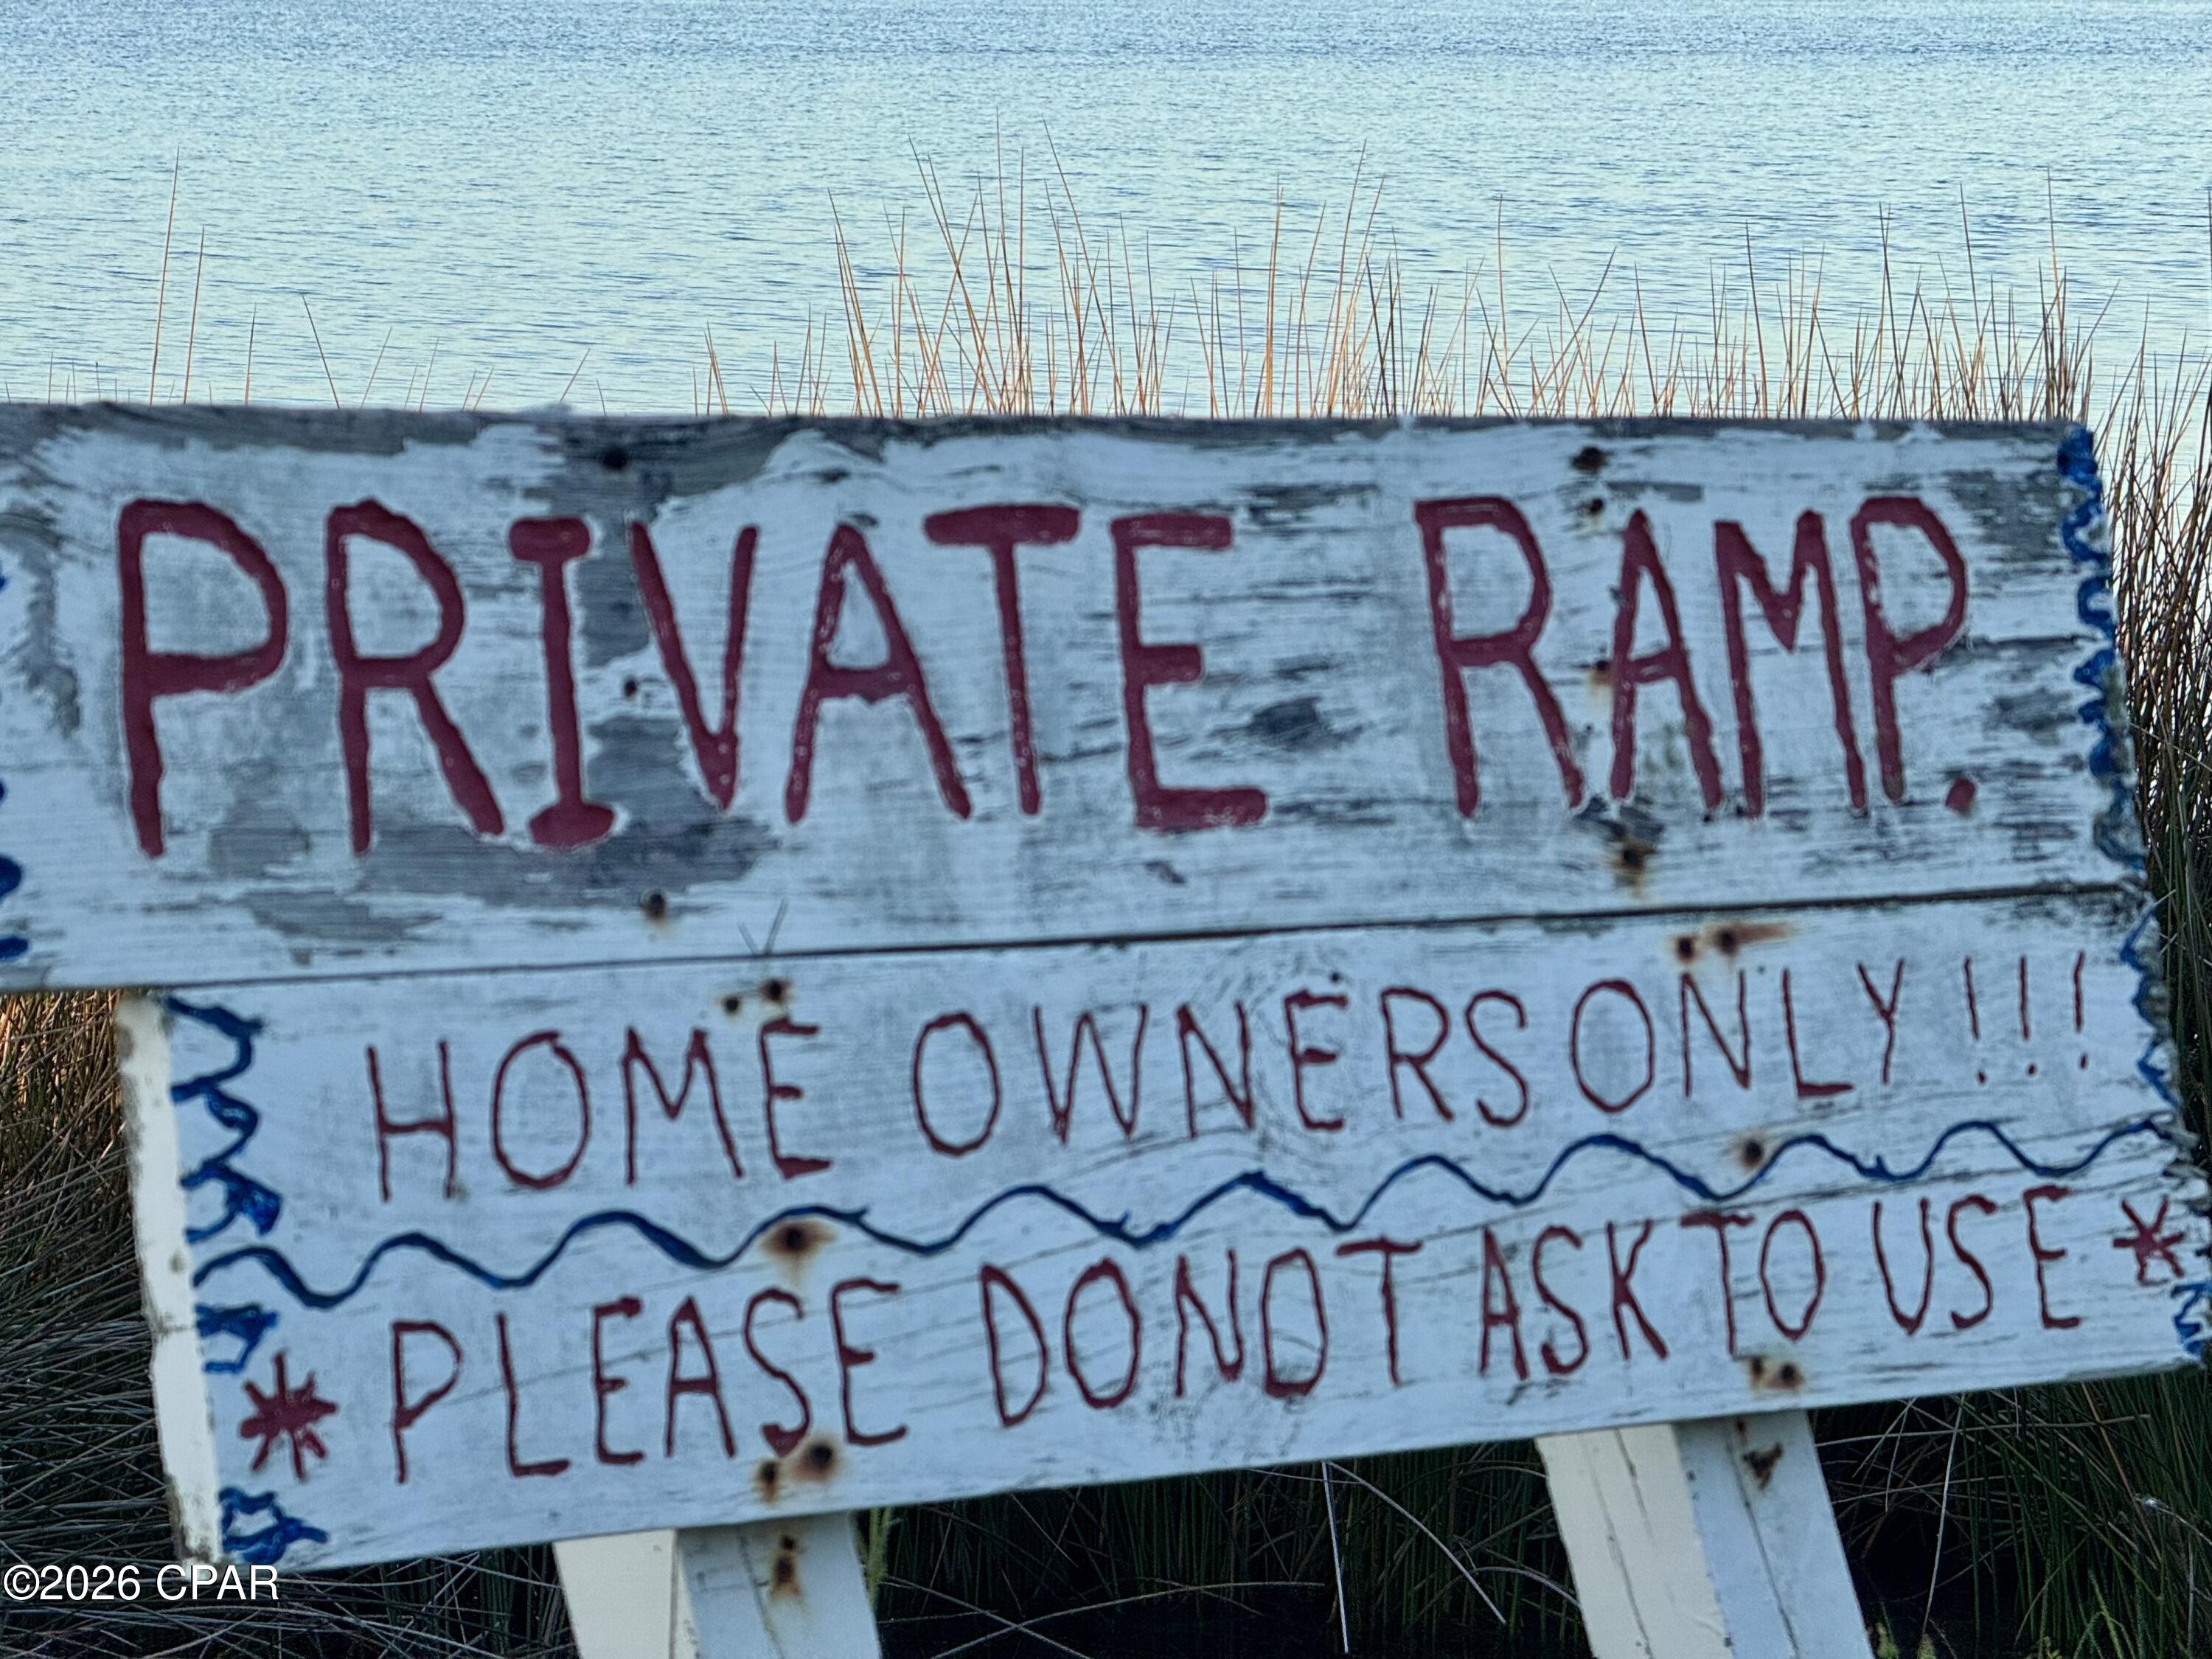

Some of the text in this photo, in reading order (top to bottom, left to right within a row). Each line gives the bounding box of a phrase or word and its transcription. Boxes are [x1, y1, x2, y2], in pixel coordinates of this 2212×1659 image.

[118, 495, 1978, 858] PRIVATE RAMP.
[366, 1018, 832, 1203] HOME
[911, 988, 1529, 1157] OWNERS
[391, 1185, 2082, 1484] PLEASE DO NOT ASK TO USE
